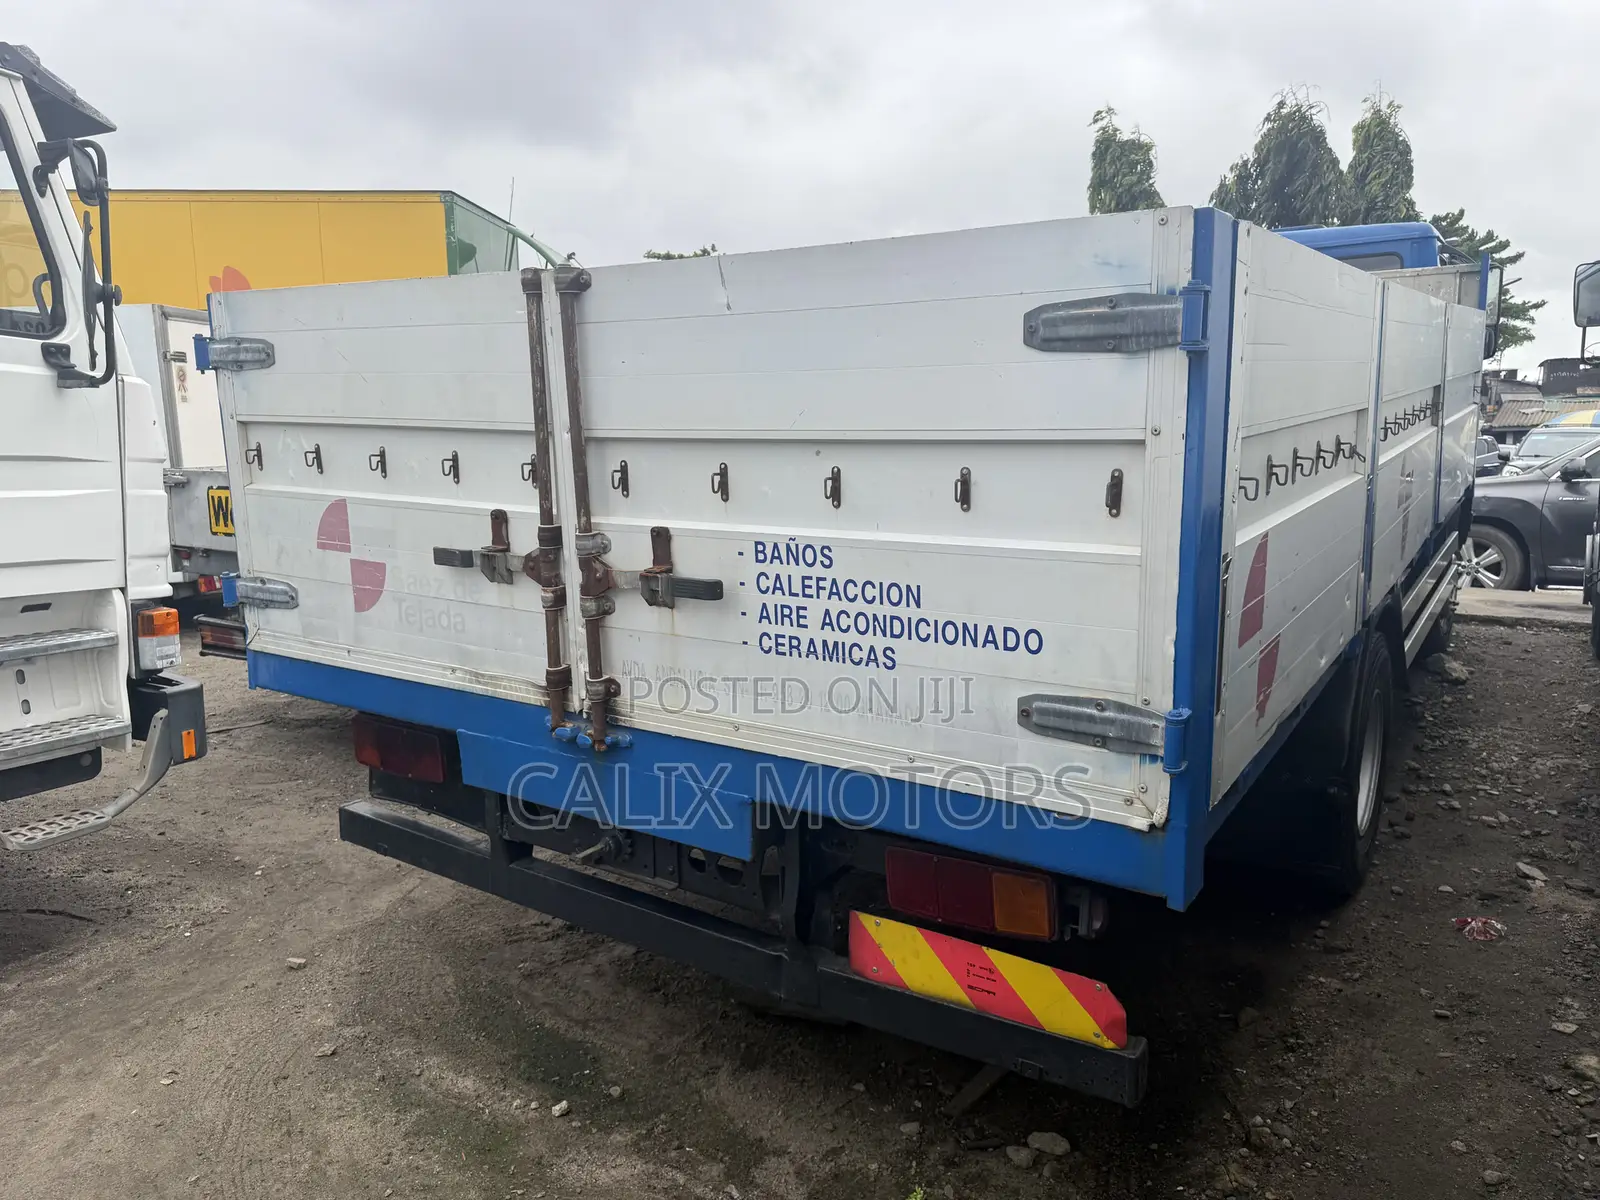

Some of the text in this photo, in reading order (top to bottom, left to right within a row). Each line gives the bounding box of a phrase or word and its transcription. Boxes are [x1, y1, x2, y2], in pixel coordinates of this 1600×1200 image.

[753, 537, 834, 569] BAÑOS
[756, 571, 922, 609] CALEFACCION
[758, 602, 809, 629] AIRE
[820, 608, 1044, 655] ACONDICIONADO
[758, 632, 897, 671] CERAMICAS
